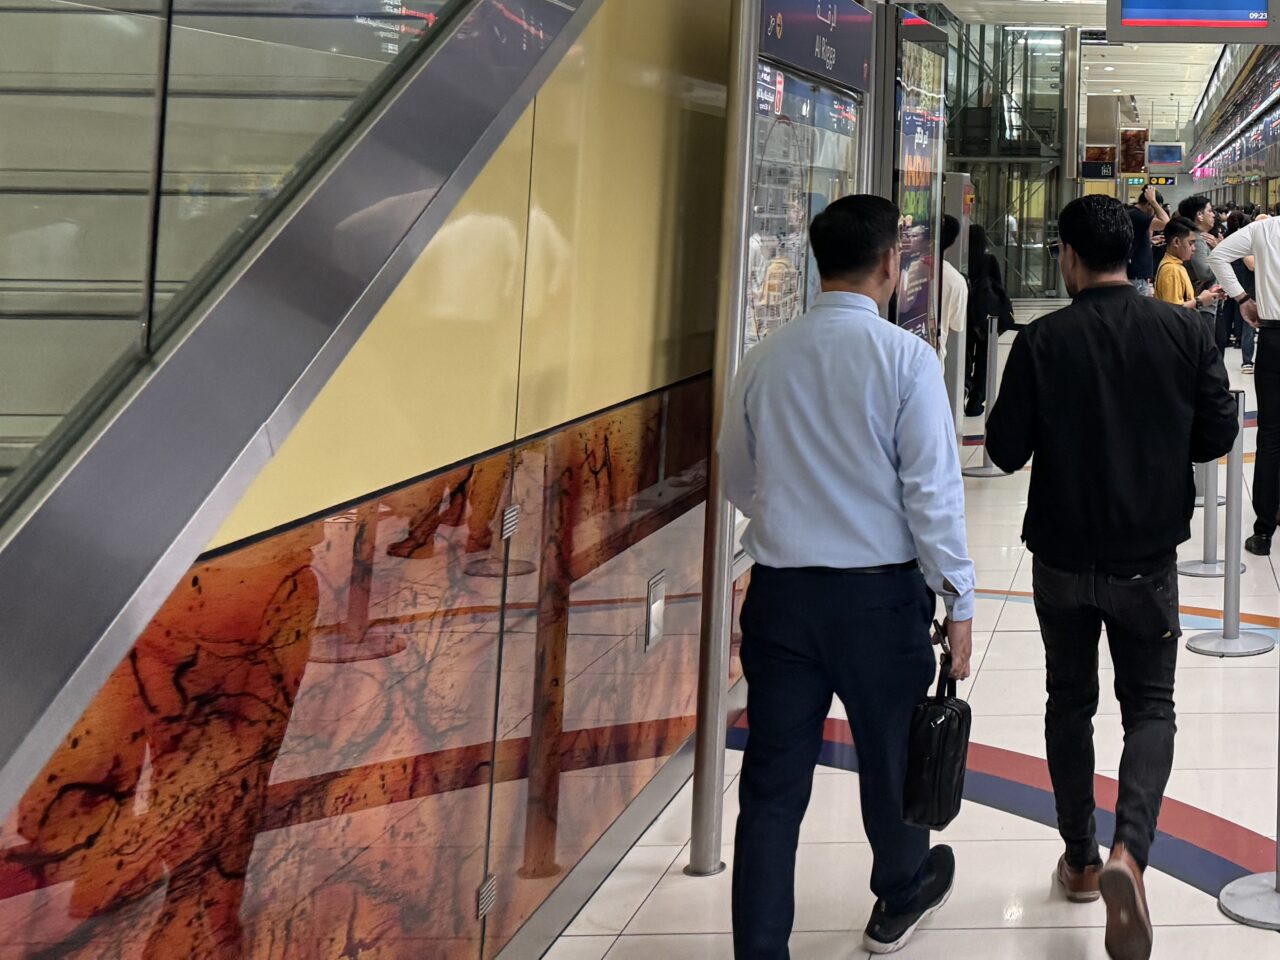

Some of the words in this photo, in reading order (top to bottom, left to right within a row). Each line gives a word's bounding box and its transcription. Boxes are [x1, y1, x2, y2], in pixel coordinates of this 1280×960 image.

[1249, 12, 1268, 20] 09:23
[814, 34, 821, 58] Al
[821, 37, 836, 70] Rigga
